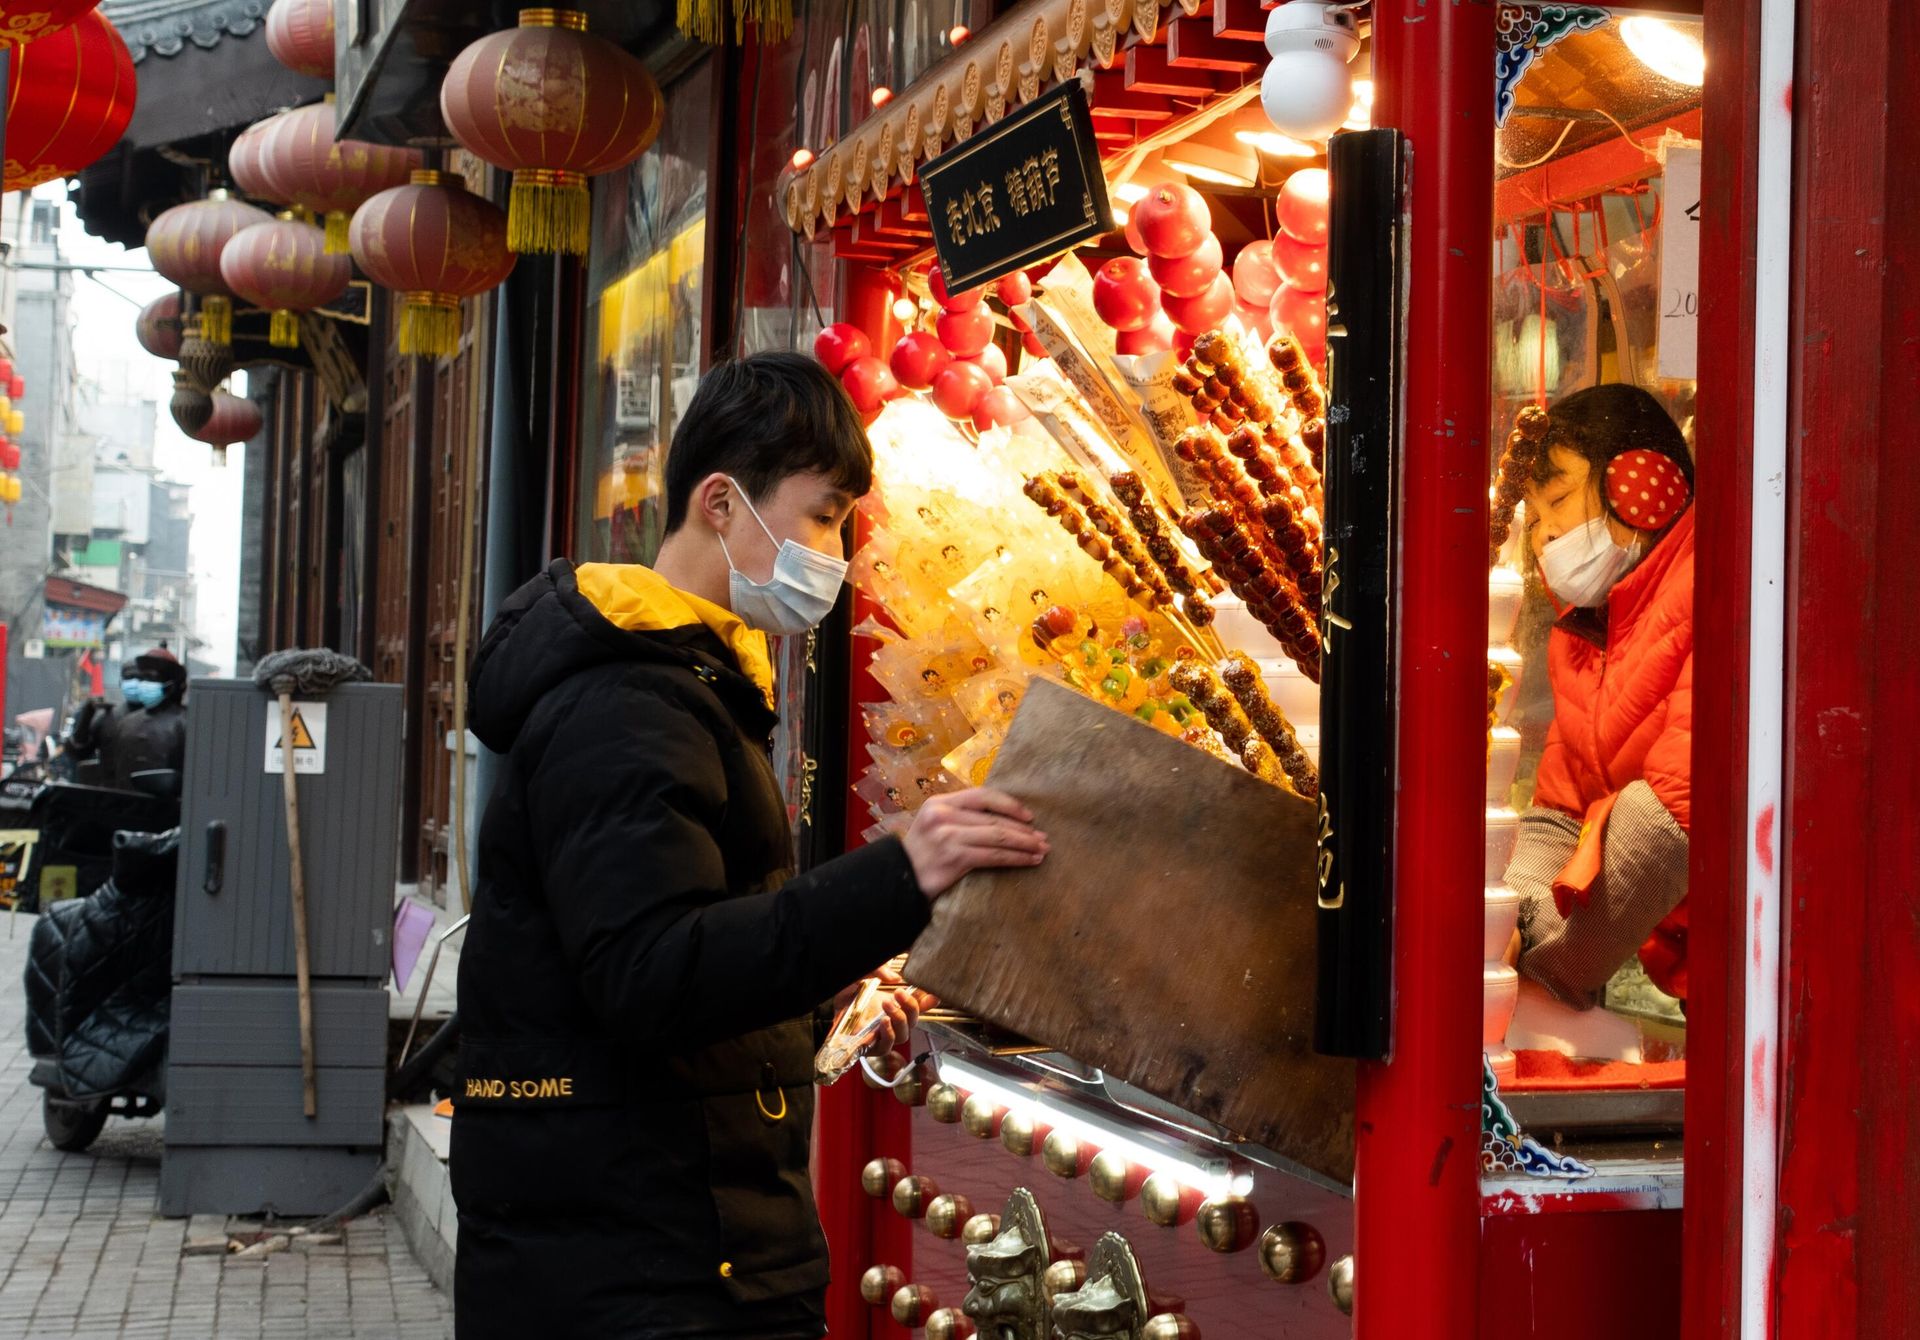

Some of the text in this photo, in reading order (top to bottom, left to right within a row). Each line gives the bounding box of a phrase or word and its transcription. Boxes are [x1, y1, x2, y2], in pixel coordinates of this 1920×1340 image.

[945, 144, 1061, 246] 老北京 糖葫芦
[465, 1078, 574, 1098] HAND SOME
[1641, 1183, 1660, 1193] Film
